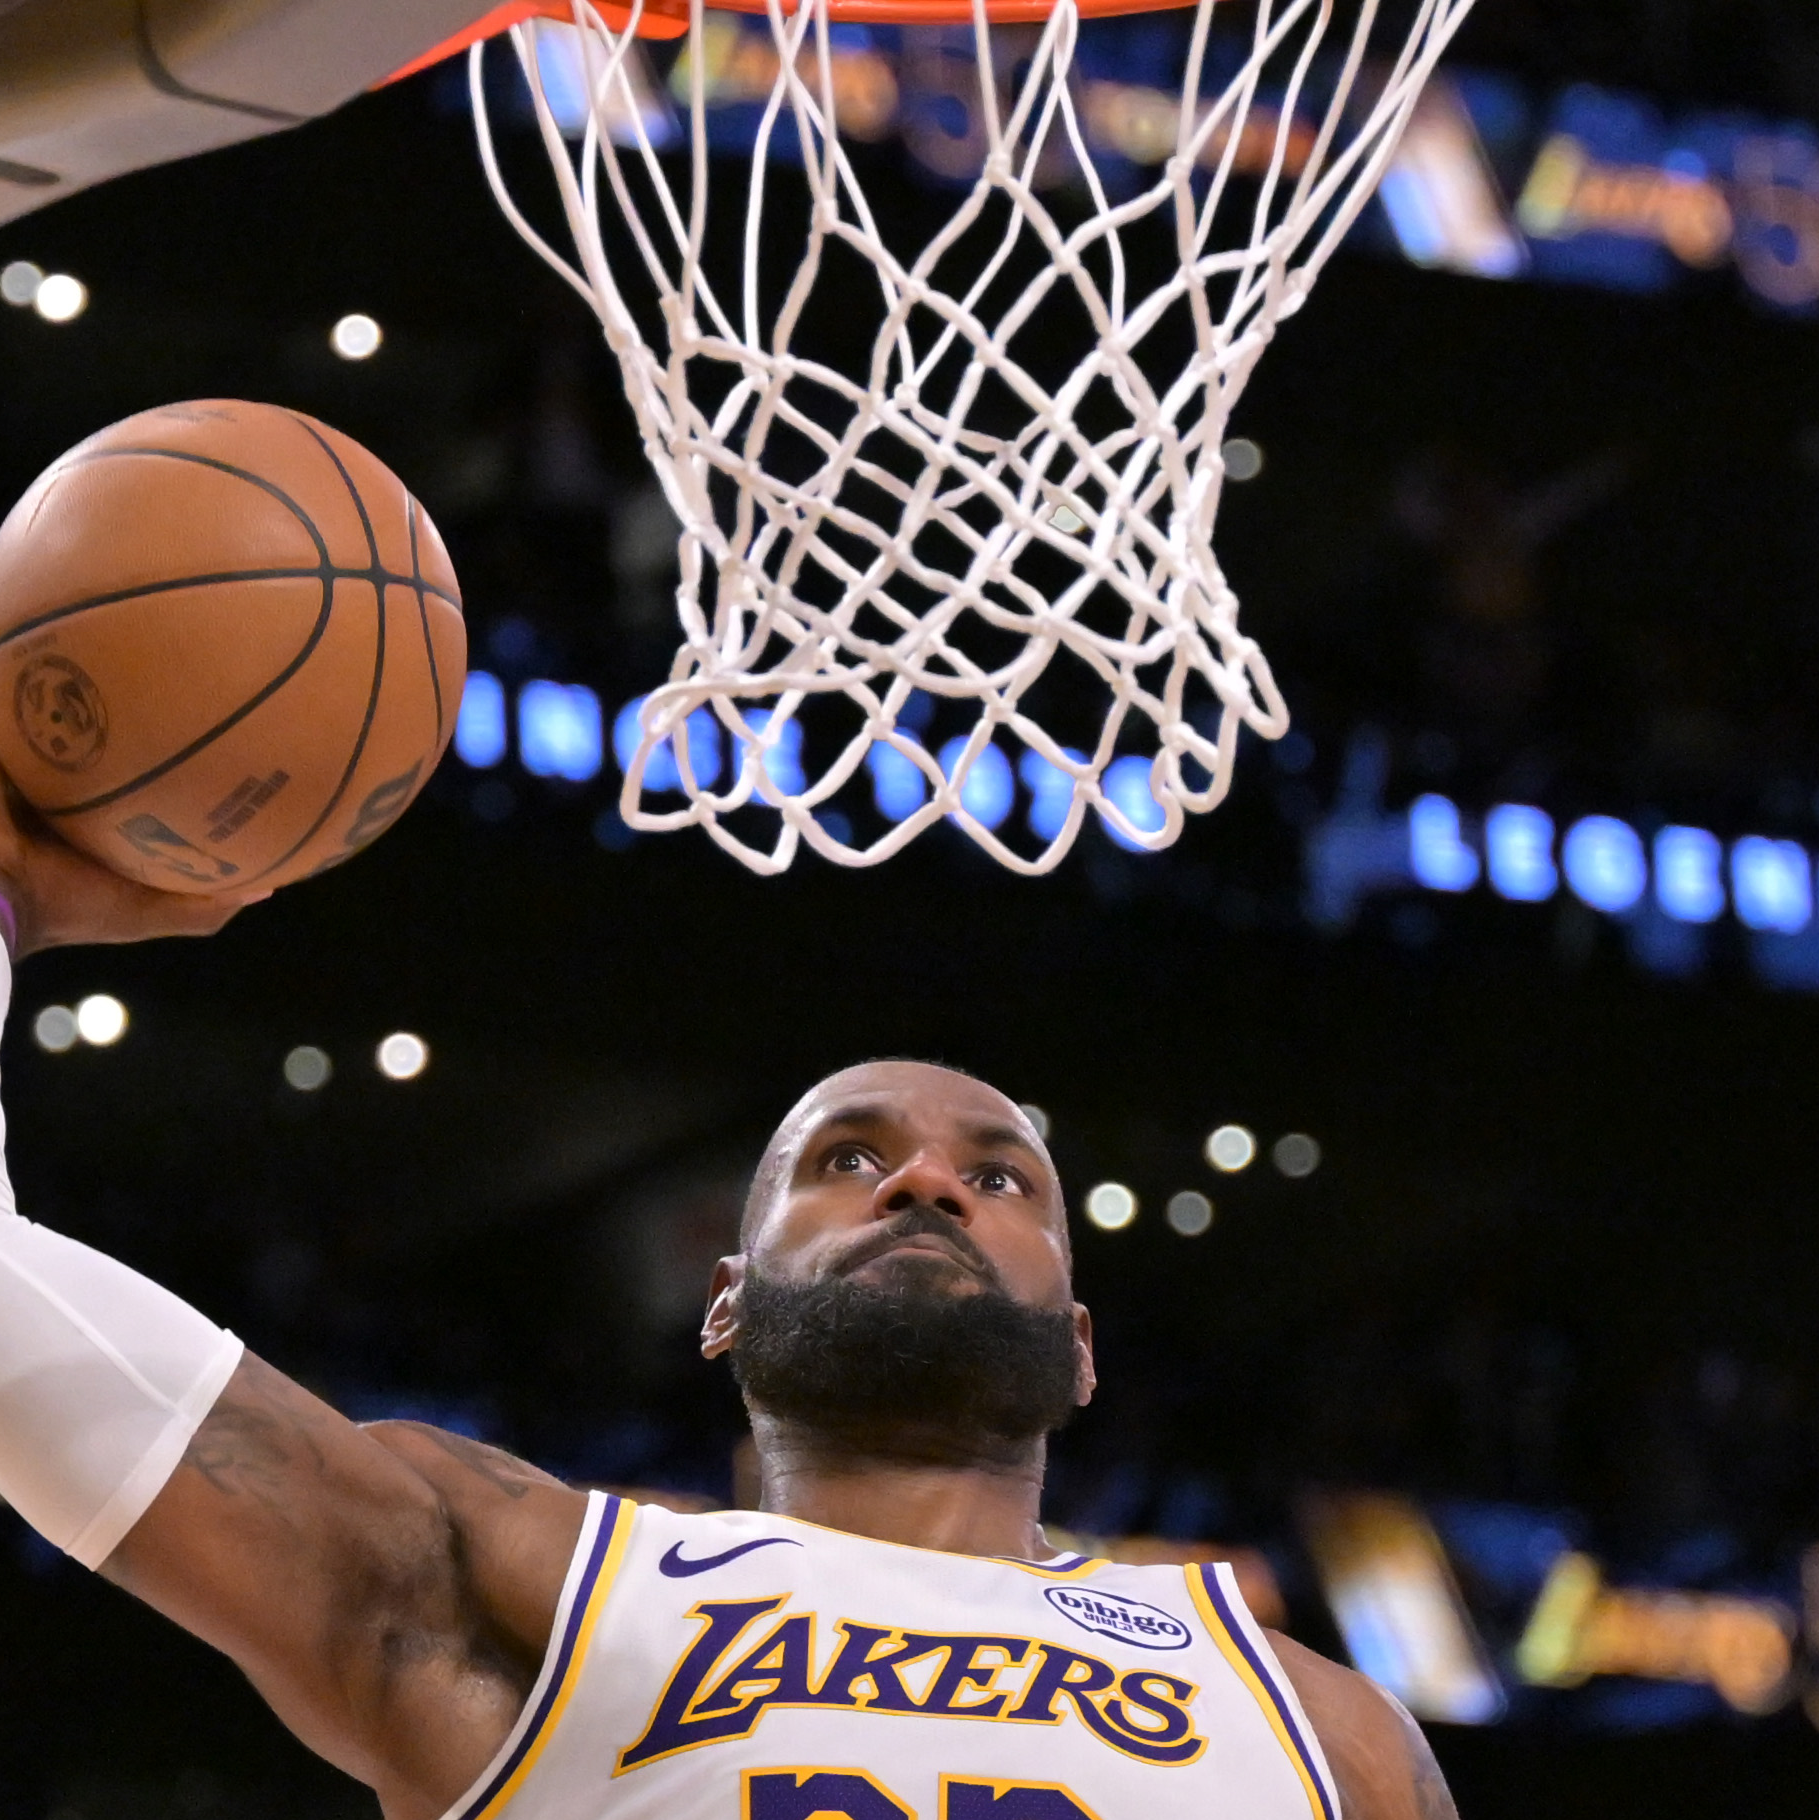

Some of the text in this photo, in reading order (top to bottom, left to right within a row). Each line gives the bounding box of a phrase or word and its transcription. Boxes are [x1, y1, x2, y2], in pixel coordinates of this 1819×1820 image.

[456, 671, 806, 806] INCE
[1056, 1592, 1182, 1637] bibigo
[611, 1592, 1208, 1777] LAKERS
